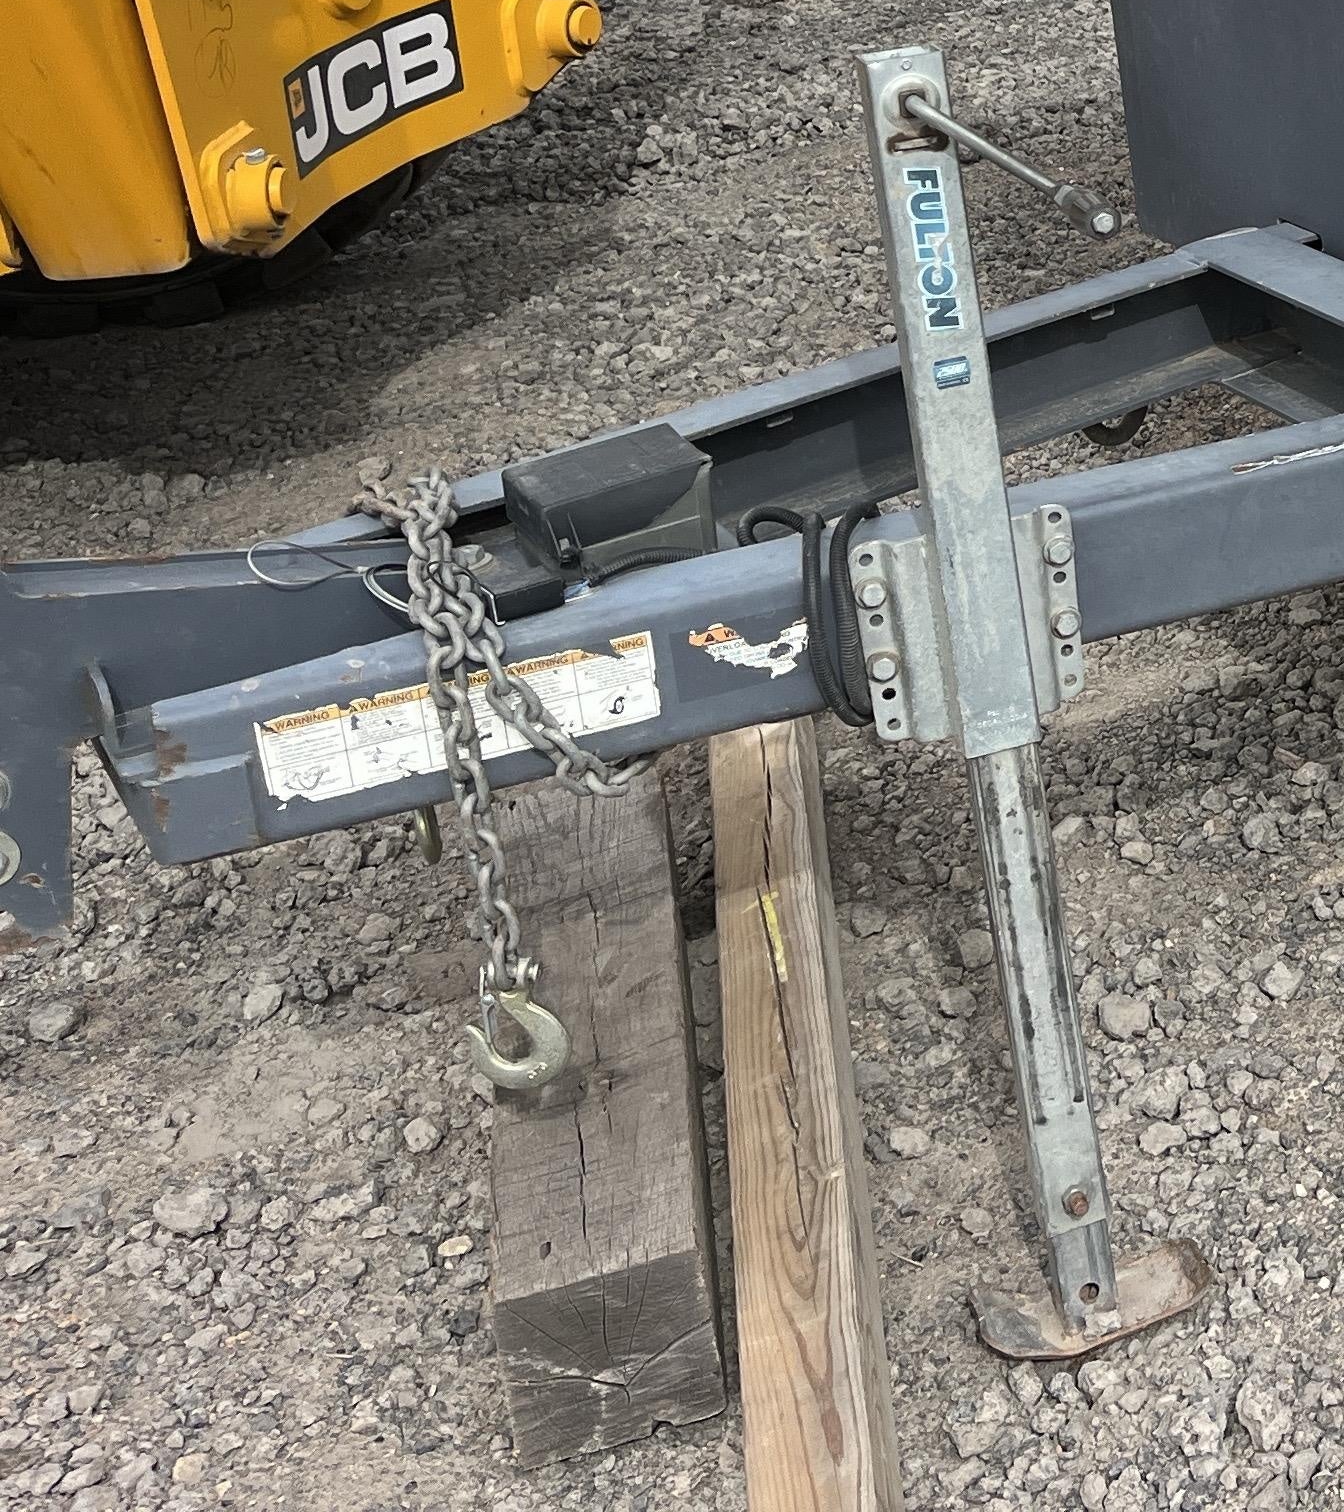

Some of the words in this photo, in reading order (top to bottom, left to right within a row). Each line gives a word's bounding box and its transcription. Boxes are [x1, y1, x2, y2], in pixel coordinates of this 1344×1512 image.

[295, 12, 457, 163] JCB
[904, 168, 964, 328] FULTON
[515, 656, 568, 675] WARNING
[358, 691, 414, 713] WARNING
[275, 711, 330, 731] WARNING
